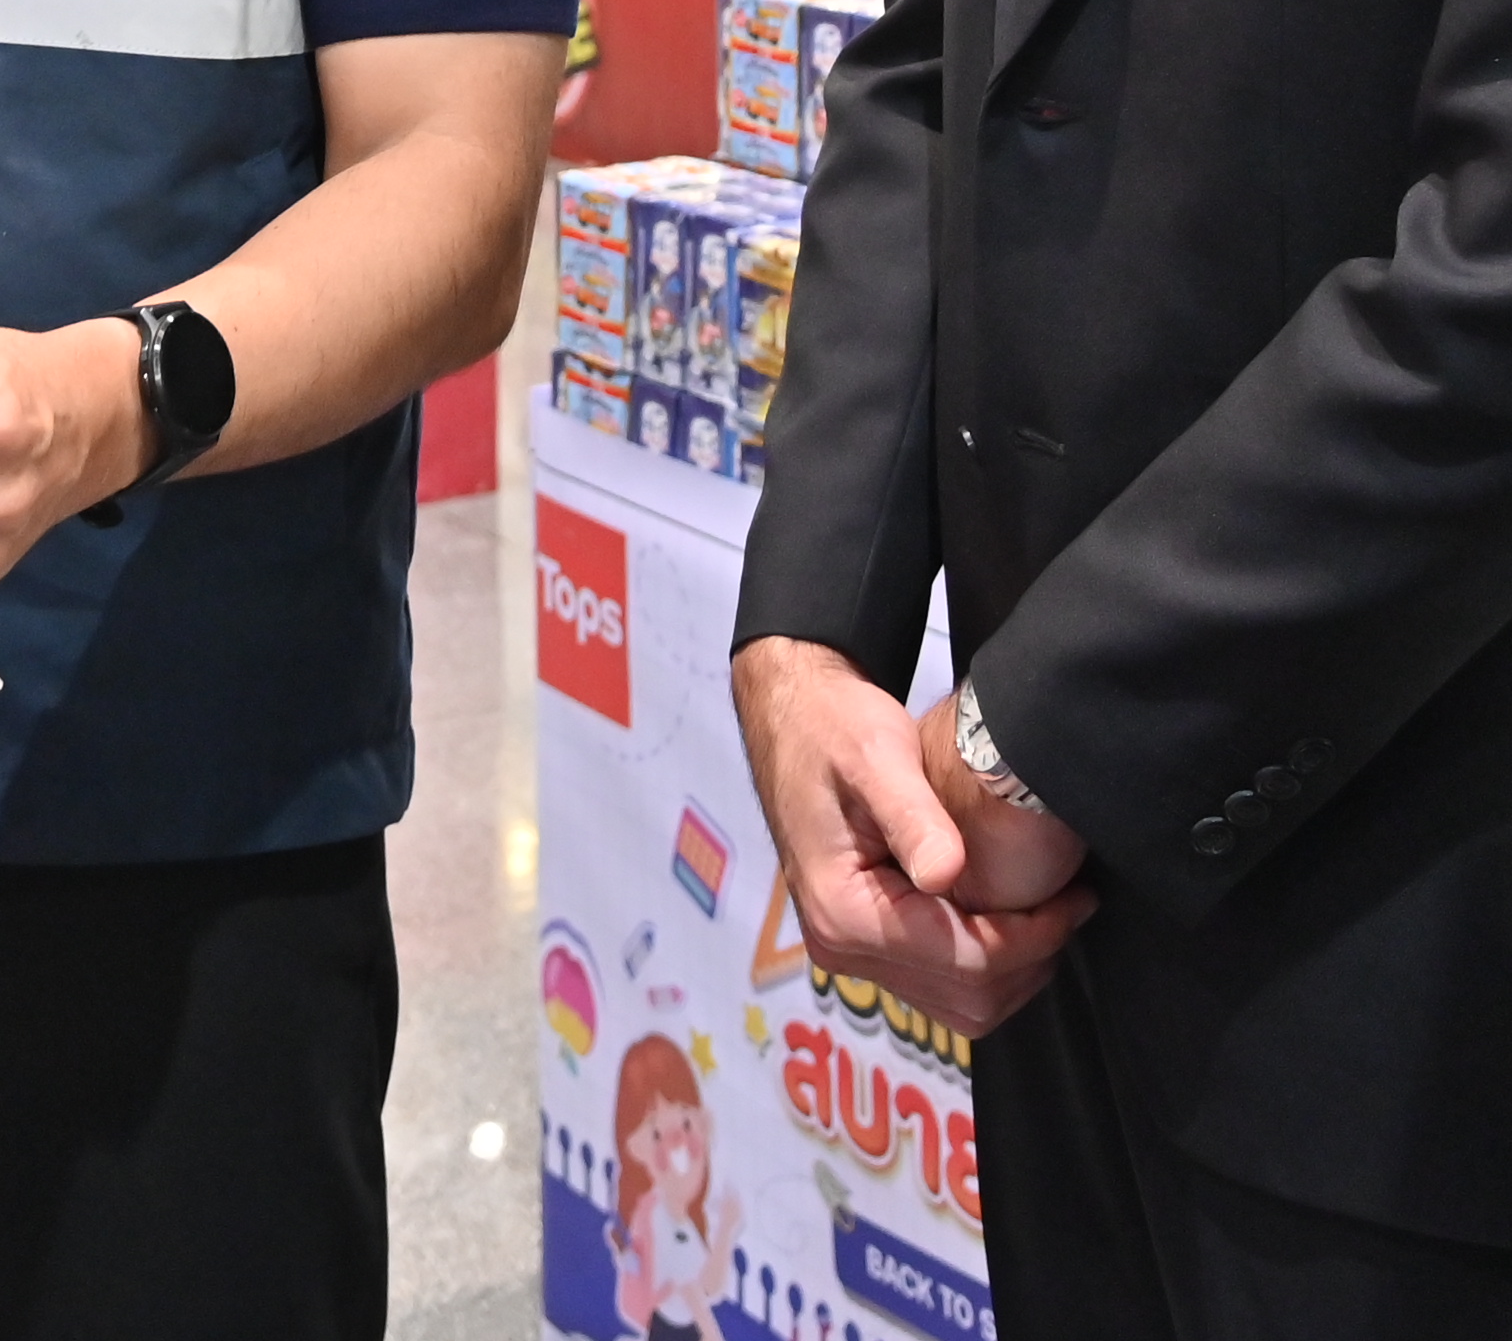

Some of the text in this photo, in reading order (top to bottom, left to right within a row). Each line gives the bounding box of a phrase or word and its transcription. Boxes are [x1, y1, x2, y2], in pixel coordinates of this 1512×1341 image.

[537, 553, 625, 649] Tops
[864, 1243, 936, 1310] BACK
[937, 1283, 974, 1329] TO
